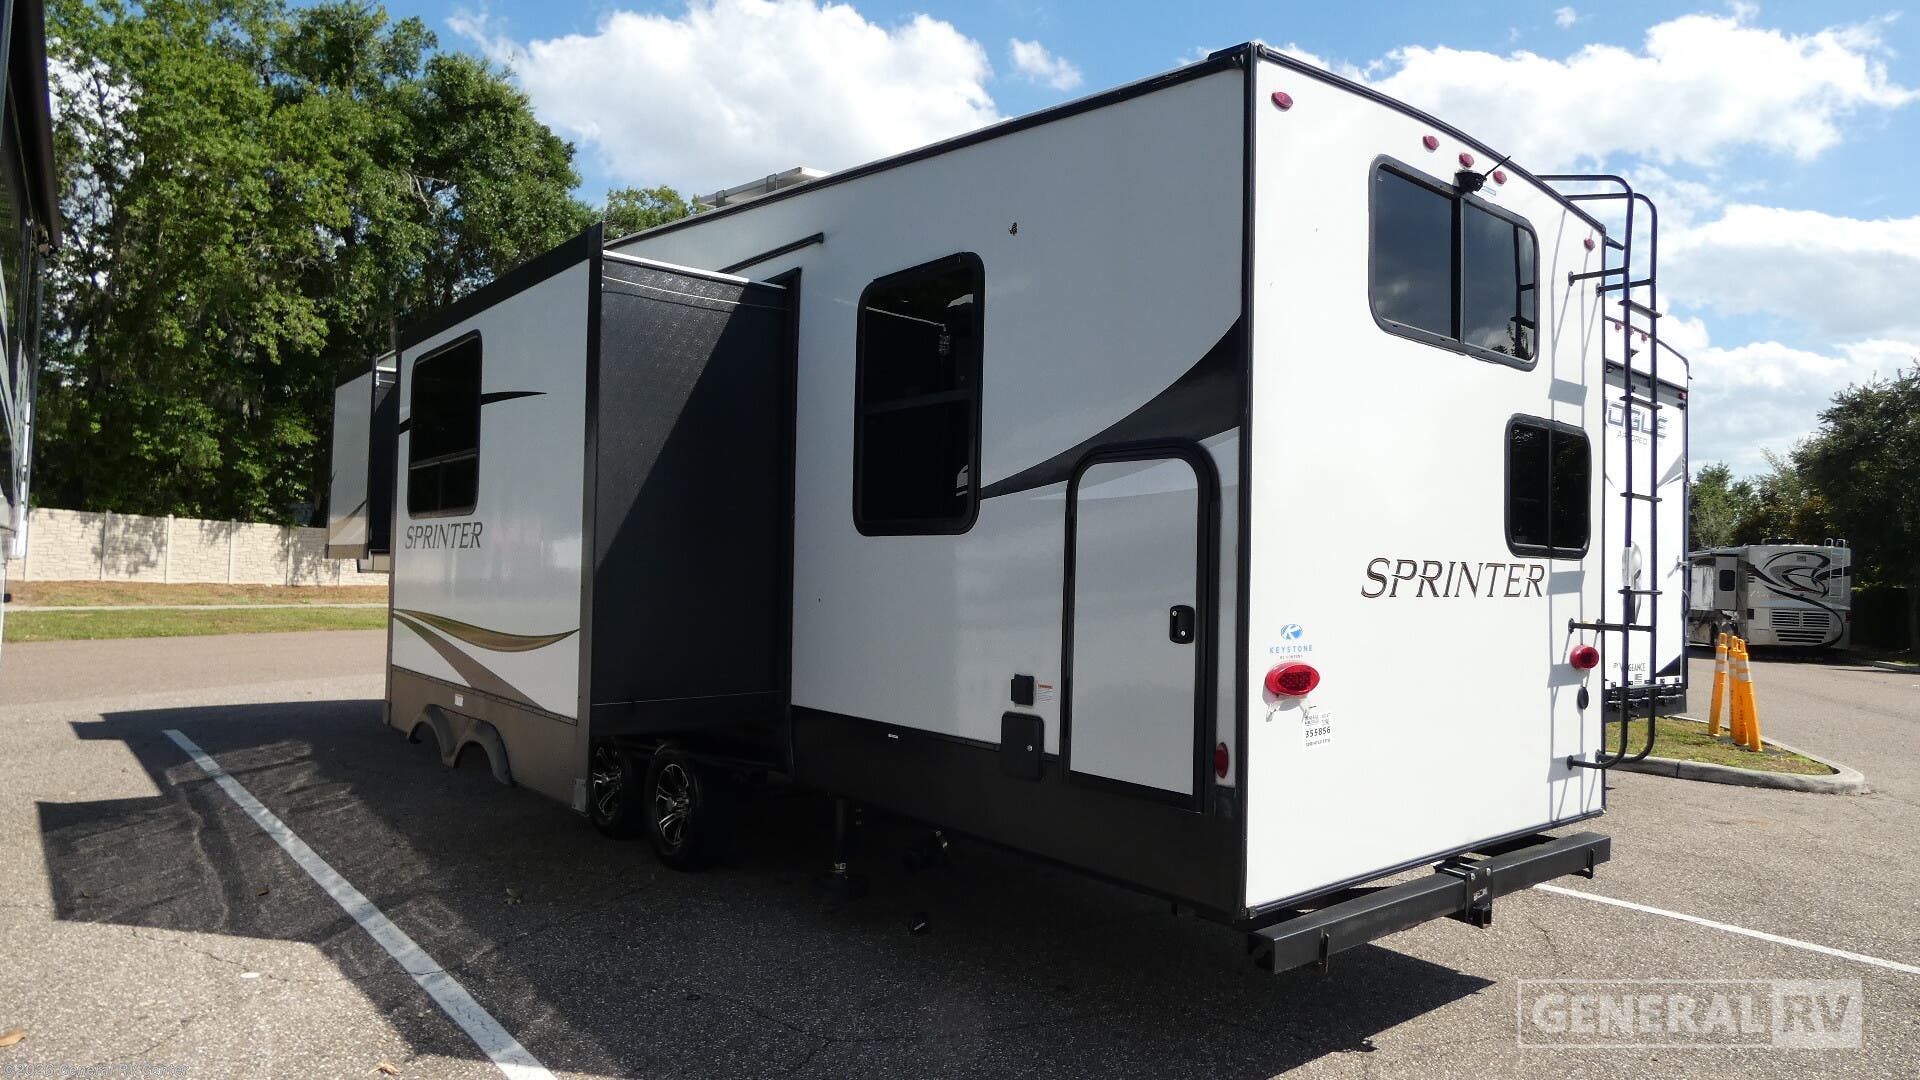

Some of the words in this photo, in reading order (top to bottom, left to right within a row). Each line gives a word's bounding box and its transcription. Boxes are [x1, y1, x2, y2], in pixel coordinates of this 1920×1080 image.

[405, 522, 483, 550] SPRINTER
[1361, 557, 1546, 599] SPRINTER
[1269, 644, 1313, 655] KEYSTONE
[1305, 726, 1331, 740] 355856
